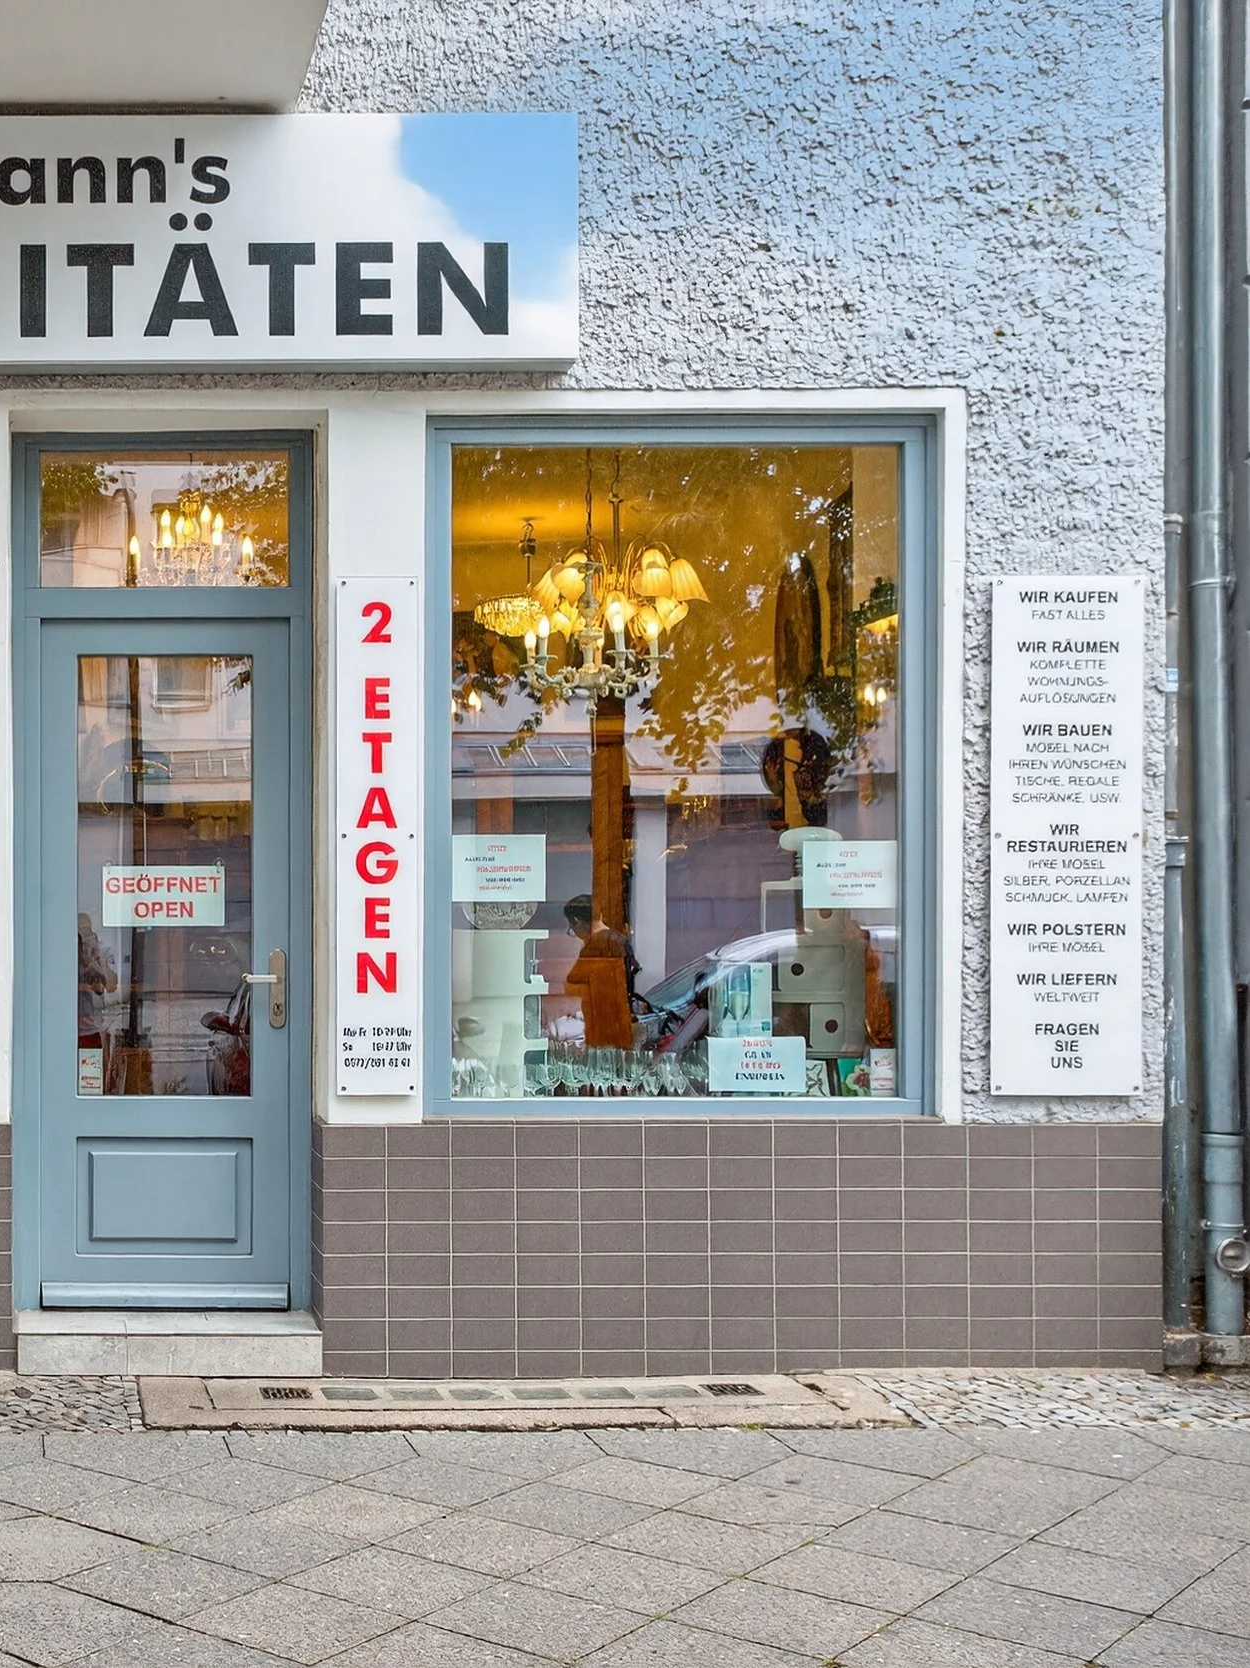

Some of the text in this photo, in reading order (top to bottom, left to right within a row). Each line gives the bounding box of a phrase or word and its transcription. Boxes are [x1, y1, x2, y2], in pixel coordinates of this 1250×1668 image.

[1019, 591, 1118, 603] WIR KAUFEN
[1032, 610, 1105, 620] FAST ALLES
[1017, 639, 1119, 653] WIR RÄUMEN
[1023, 724, 1112, 736] WIR BAUEN
[355, 601, 399, 994] 2 ETAGEN
[1050, 824, 1079, 836] WIR
[1007, 840, 1127, 853] RESTAURIEREN
[106, 874, 221, 893] GEÖFFNET
[134, 901, 194, 918] OPEN
[1007, 923, 1126, 936] WIR POLSTERN
[1017, 973, 1117, 986] WIR LIEFERN
[1034, 992, 1099, 1002] WELTWEIT
[1035, 1023, 1099, 1036] FRAGEN
[1055, 1040, 1079, 1052] SIE
[1051, 1056, 1083, 1068] UNS
